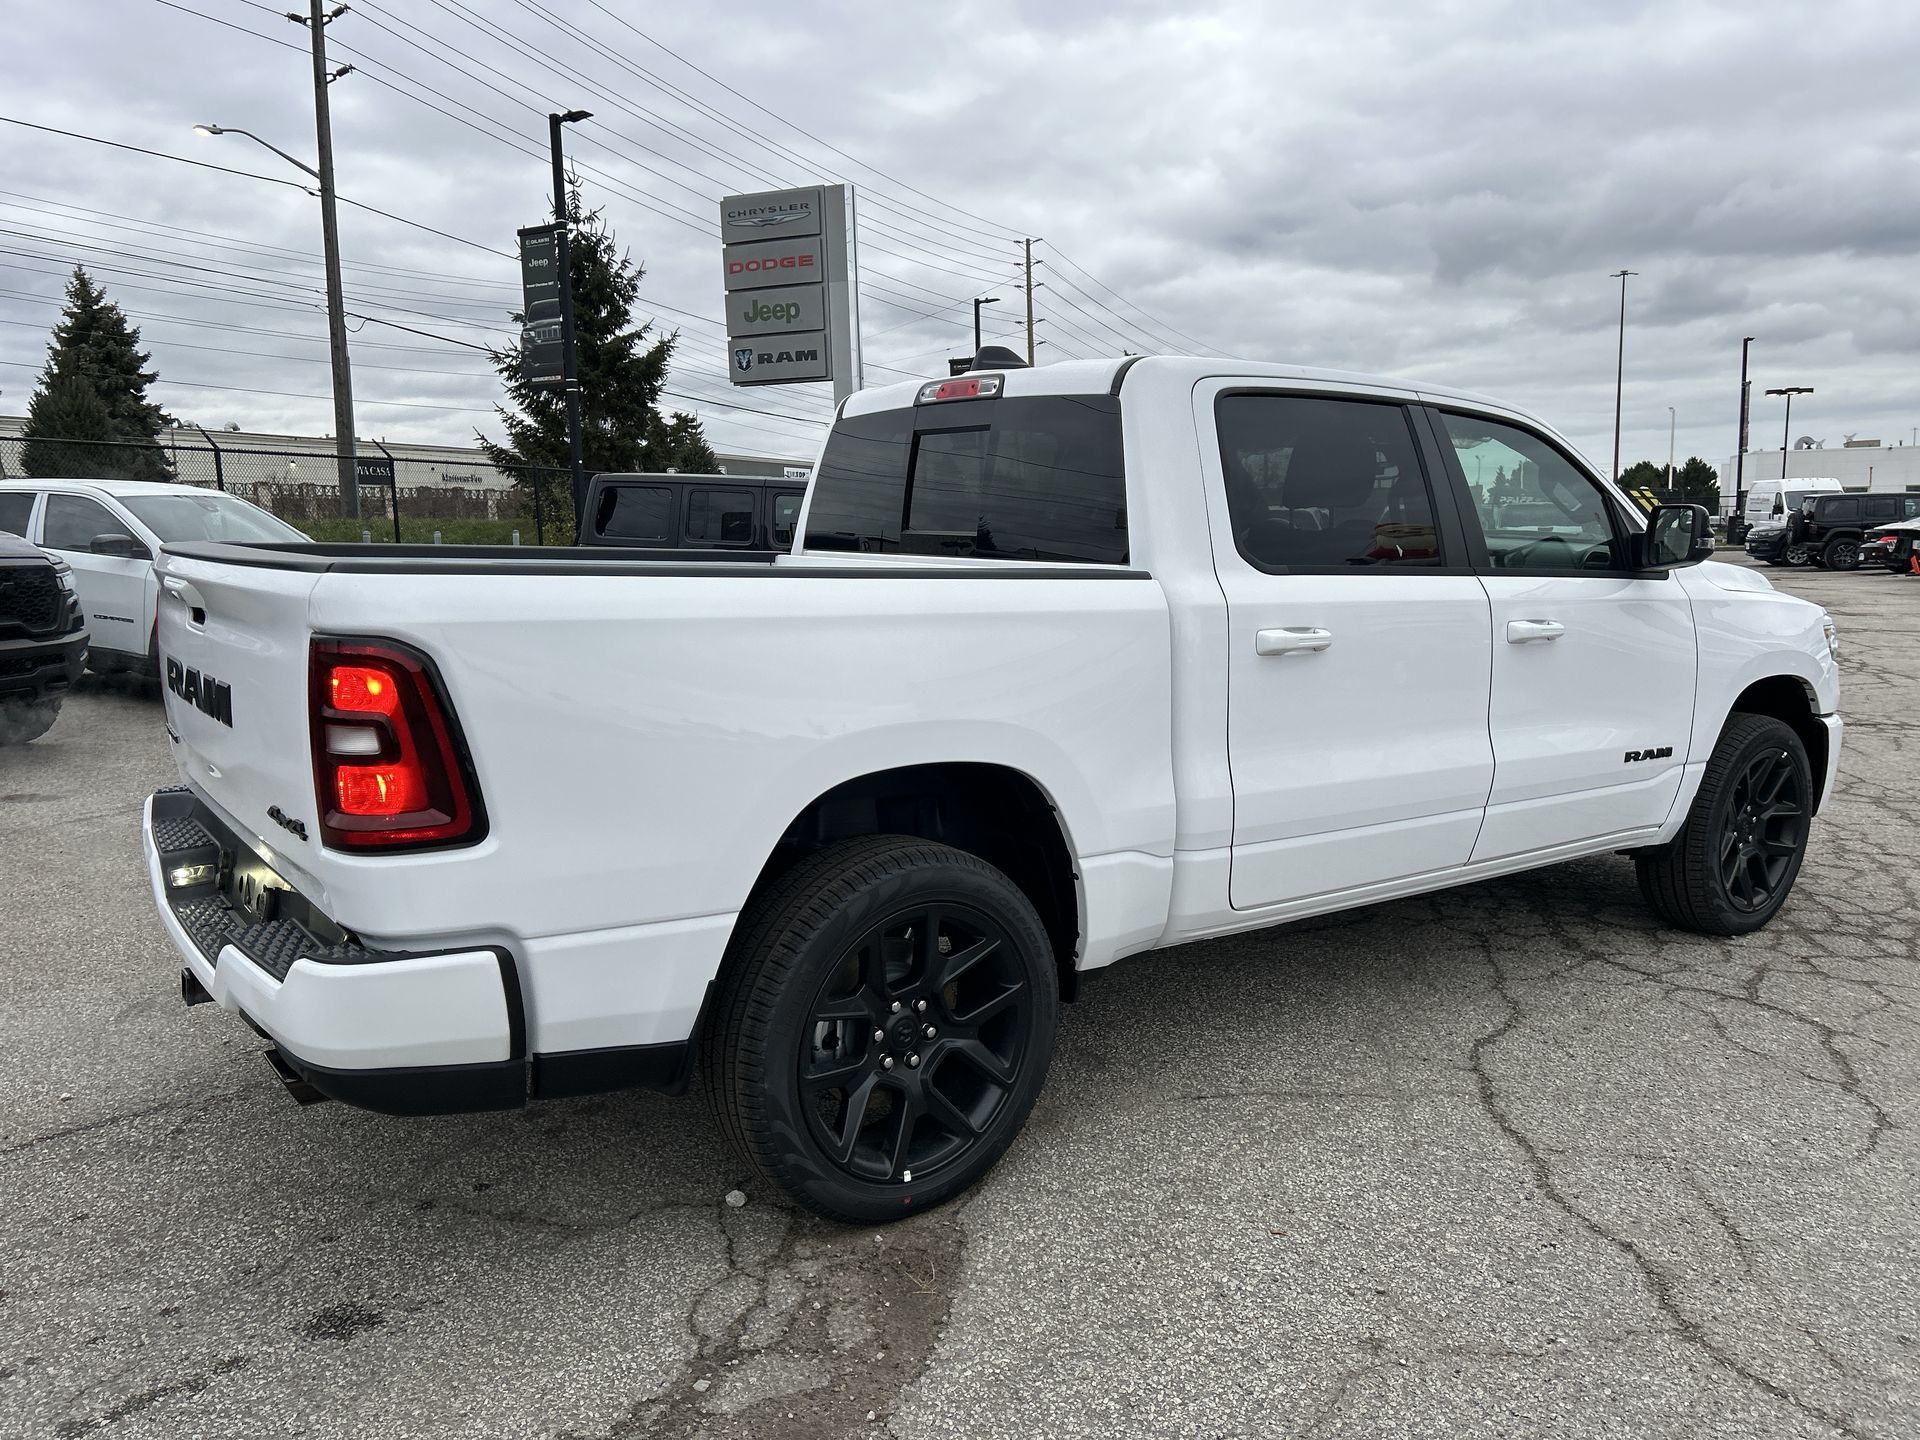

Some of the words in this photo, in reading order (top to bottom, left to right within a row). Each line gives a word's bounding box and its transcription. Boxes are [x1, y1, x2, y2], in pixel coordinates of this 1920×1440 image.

[728, 202, 809, 218] CHRYSLER
[528, 258, 549, 268] Jeep
[729, 254, 814, 275] DODGE
[744, 299, 801, 324] Jeep
[757, 349, 818, 365] RAM
[369, 466, 391, 476] CASA
[166, 655, 234, 729] RAM
[1624, 746, 1673, 763] RAM
